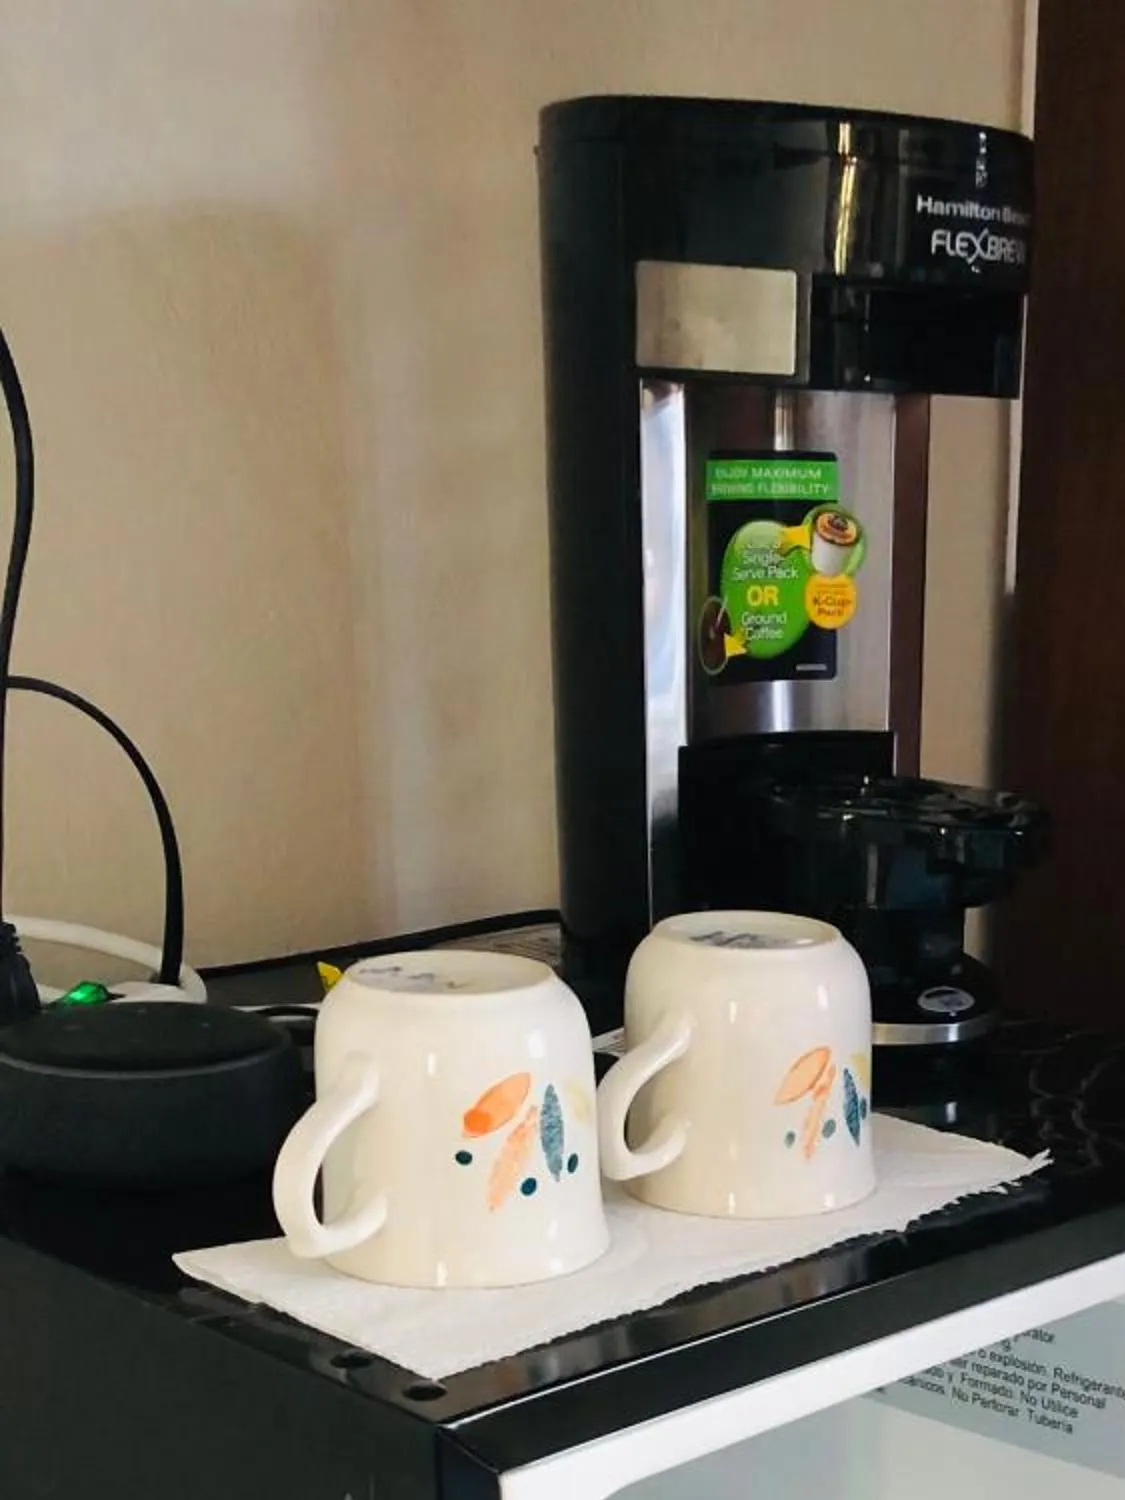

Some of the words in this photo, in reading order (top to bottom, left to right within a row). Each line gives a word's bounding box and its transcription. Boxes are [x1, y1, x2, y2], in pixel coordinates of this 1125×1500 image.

[916, 194, 1000, 221] Hamilton
[751, 467, 822, 479] MAXIMUM
[746, 585, 779, 607] OR
[741, 611, 787, 626] Ground
[971, 1361, 1024, 1386] reparado
[1051, 1382, 1106, 1409] Personal
